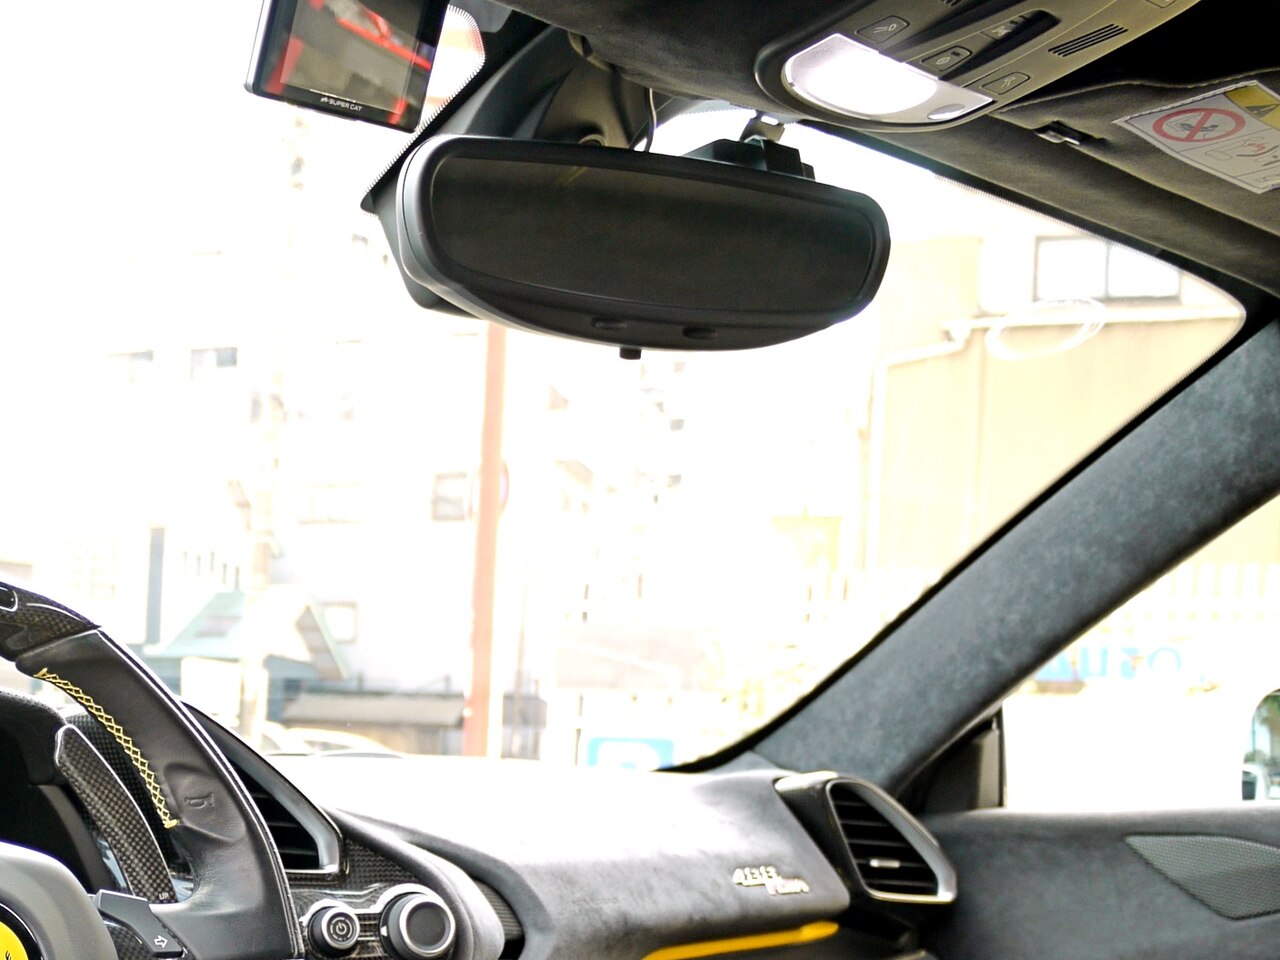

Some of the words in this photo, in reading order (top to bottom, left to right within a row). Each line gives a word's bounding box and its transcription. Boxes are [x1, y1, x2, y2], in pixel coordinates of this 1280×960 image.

[329, 99, 350, 110] SUPER
[350, 103, 363, 112] CAT
[159, 892, 170, 900] UP
